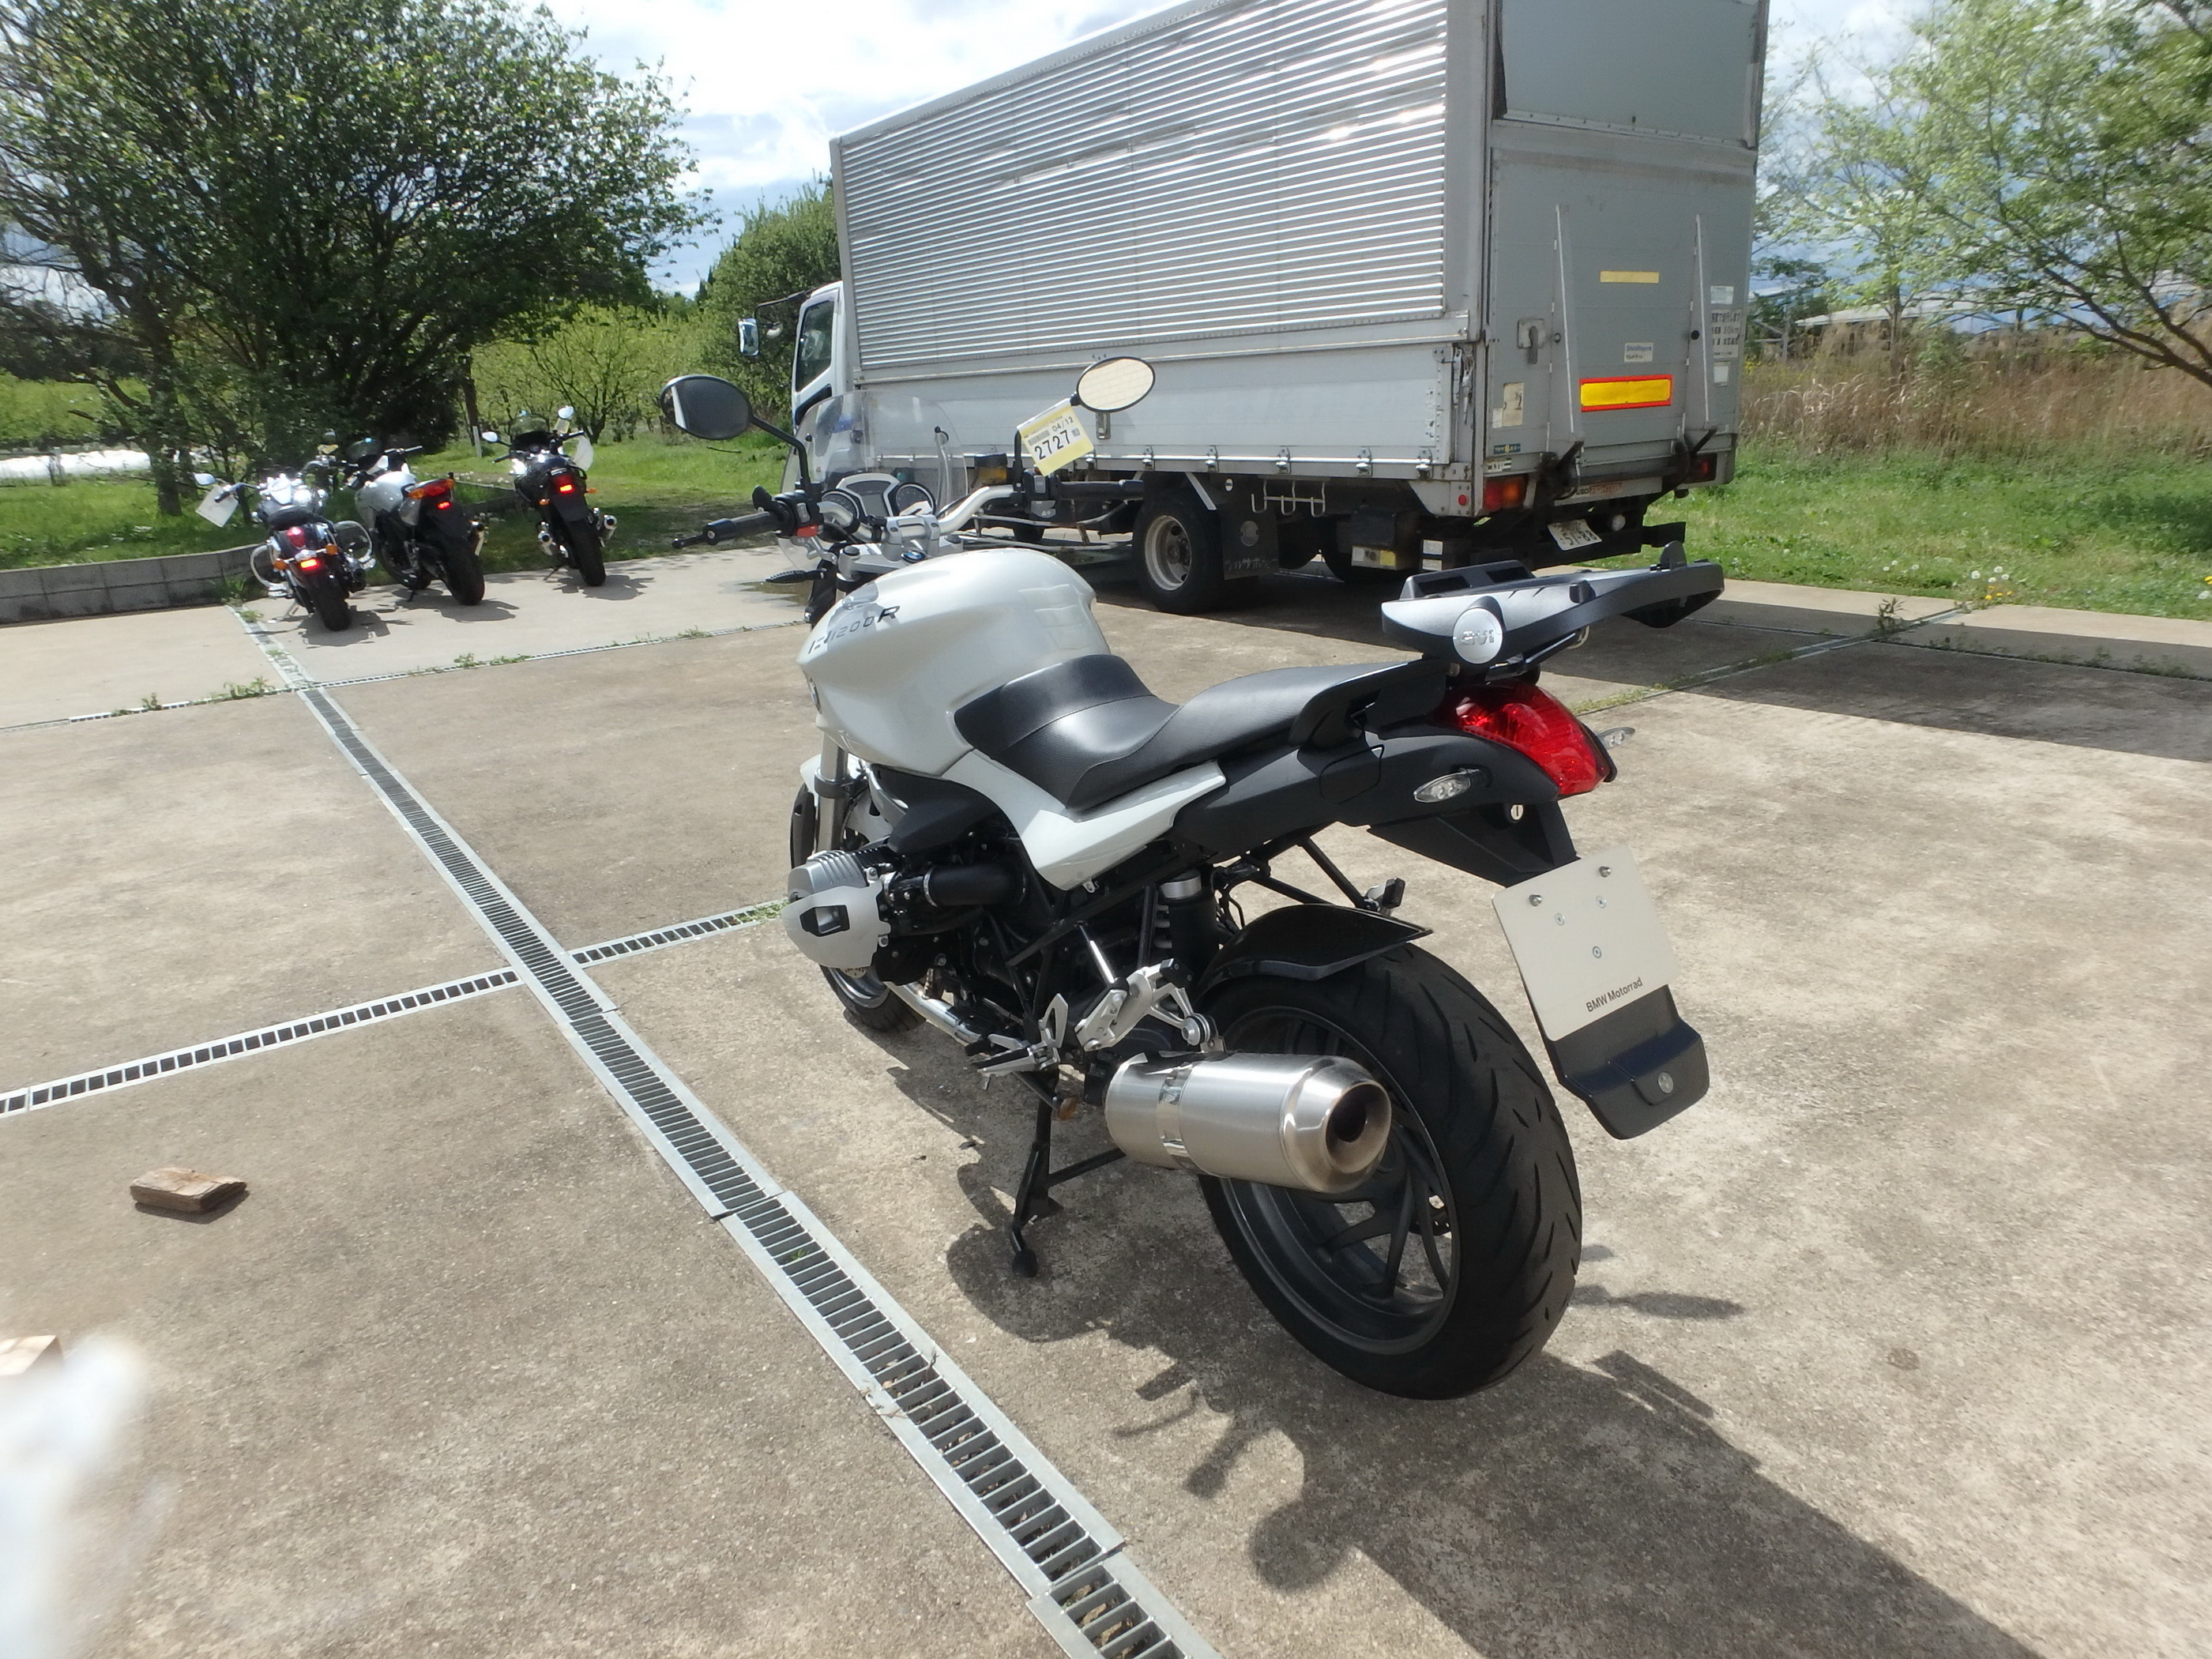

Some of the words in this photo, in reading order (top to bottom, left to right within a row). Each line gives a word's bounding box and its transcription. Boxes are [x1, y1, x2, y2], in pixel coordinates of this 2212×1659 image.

[1051, 416, 1074, 432] 04/12
[1035, 429, 1070, 460] 2727
[1586, 995, 1608, 1013] BMW
[1608, 976, 1643, 1002] Motorrad
